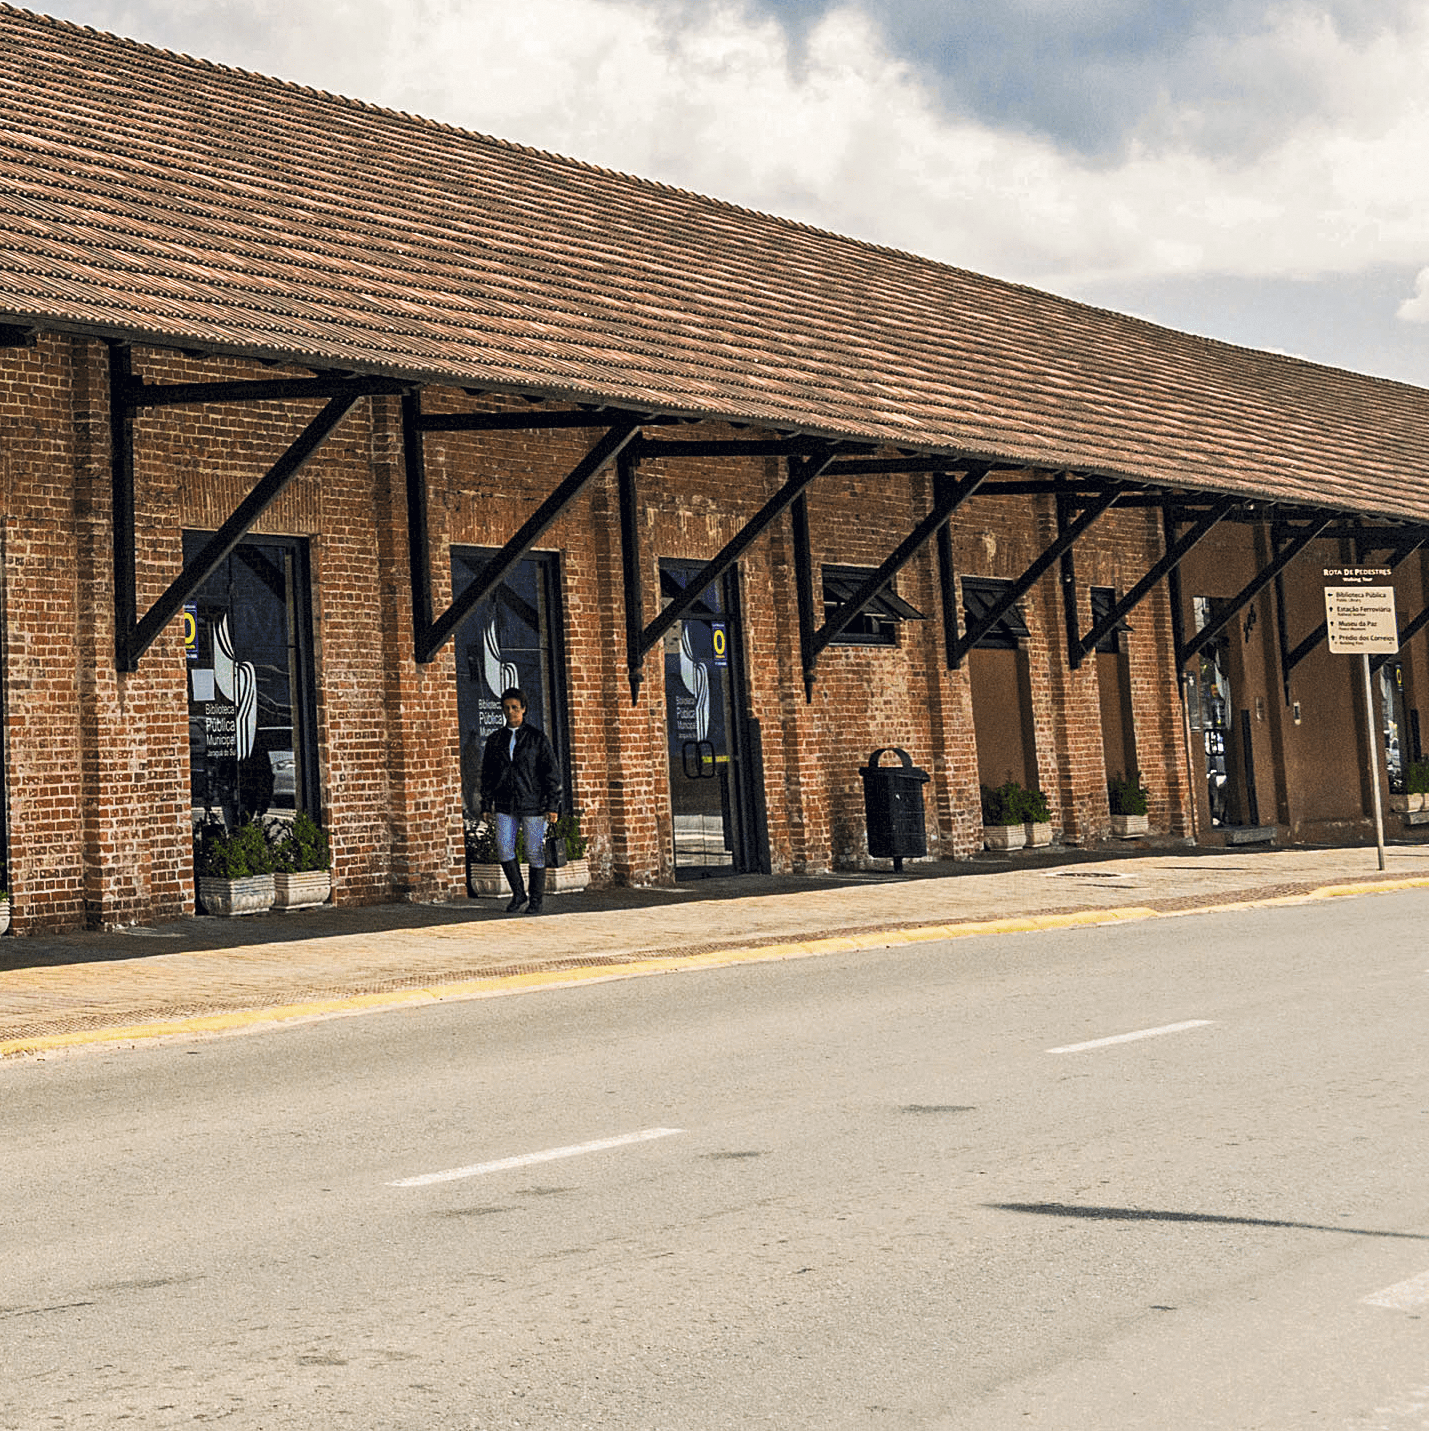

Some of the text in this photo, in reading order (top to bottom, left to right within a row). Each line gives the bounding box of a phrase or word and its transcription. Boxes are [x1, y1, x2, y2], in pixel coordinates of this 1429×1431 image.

[1354, 568, 1392, 576] PEDESTRES
[206, 703, 235, 715] Biblioteca
[206, 717, 236, 732] Pública
